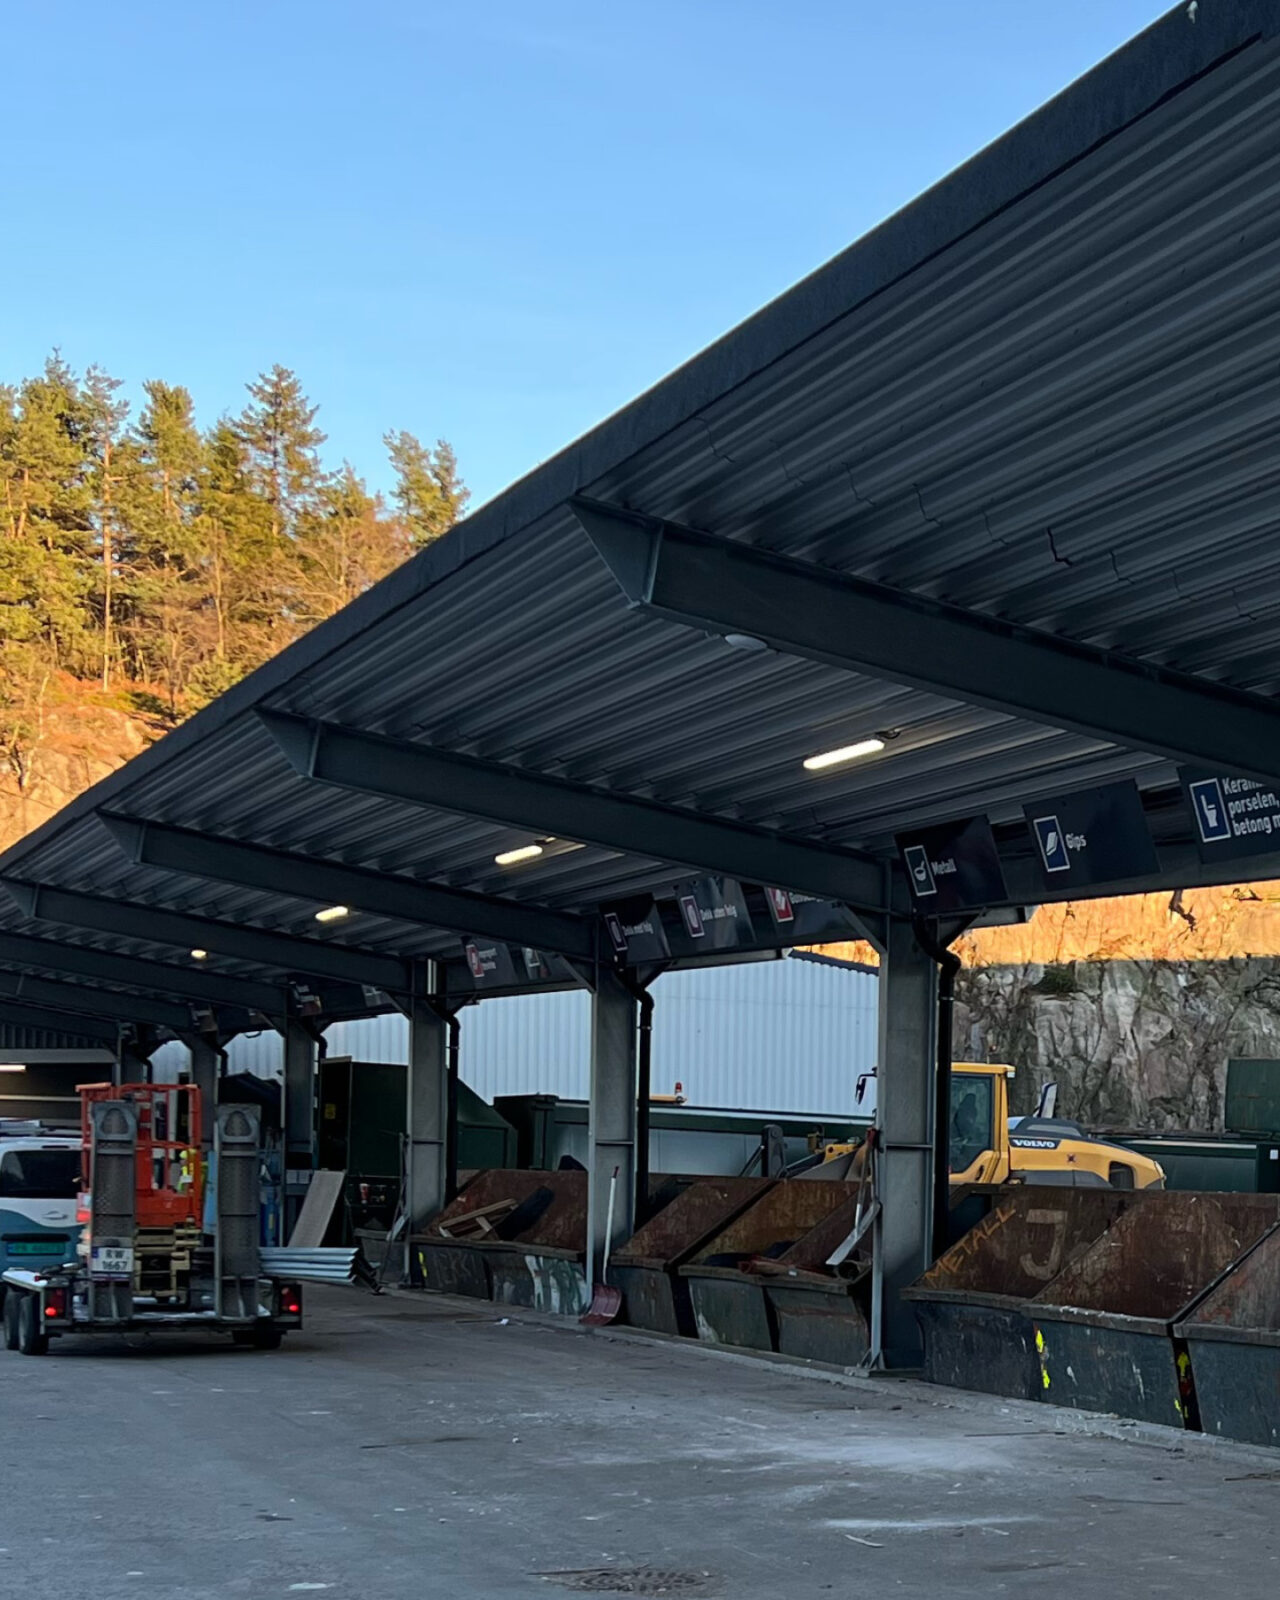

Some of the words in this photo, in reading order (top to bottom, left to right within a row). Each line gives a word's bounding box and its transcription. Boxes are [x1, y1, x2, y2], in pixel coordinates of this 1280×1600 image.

[1227, 791, 1280, 819] porselen,
[1231, 817, 1273, 837] betong
[1064, 833, 1087, 852] Gips
[1012, 1138, 1056, 1148] VOLVO
[924, 1206, 1017, 1289] METALL
